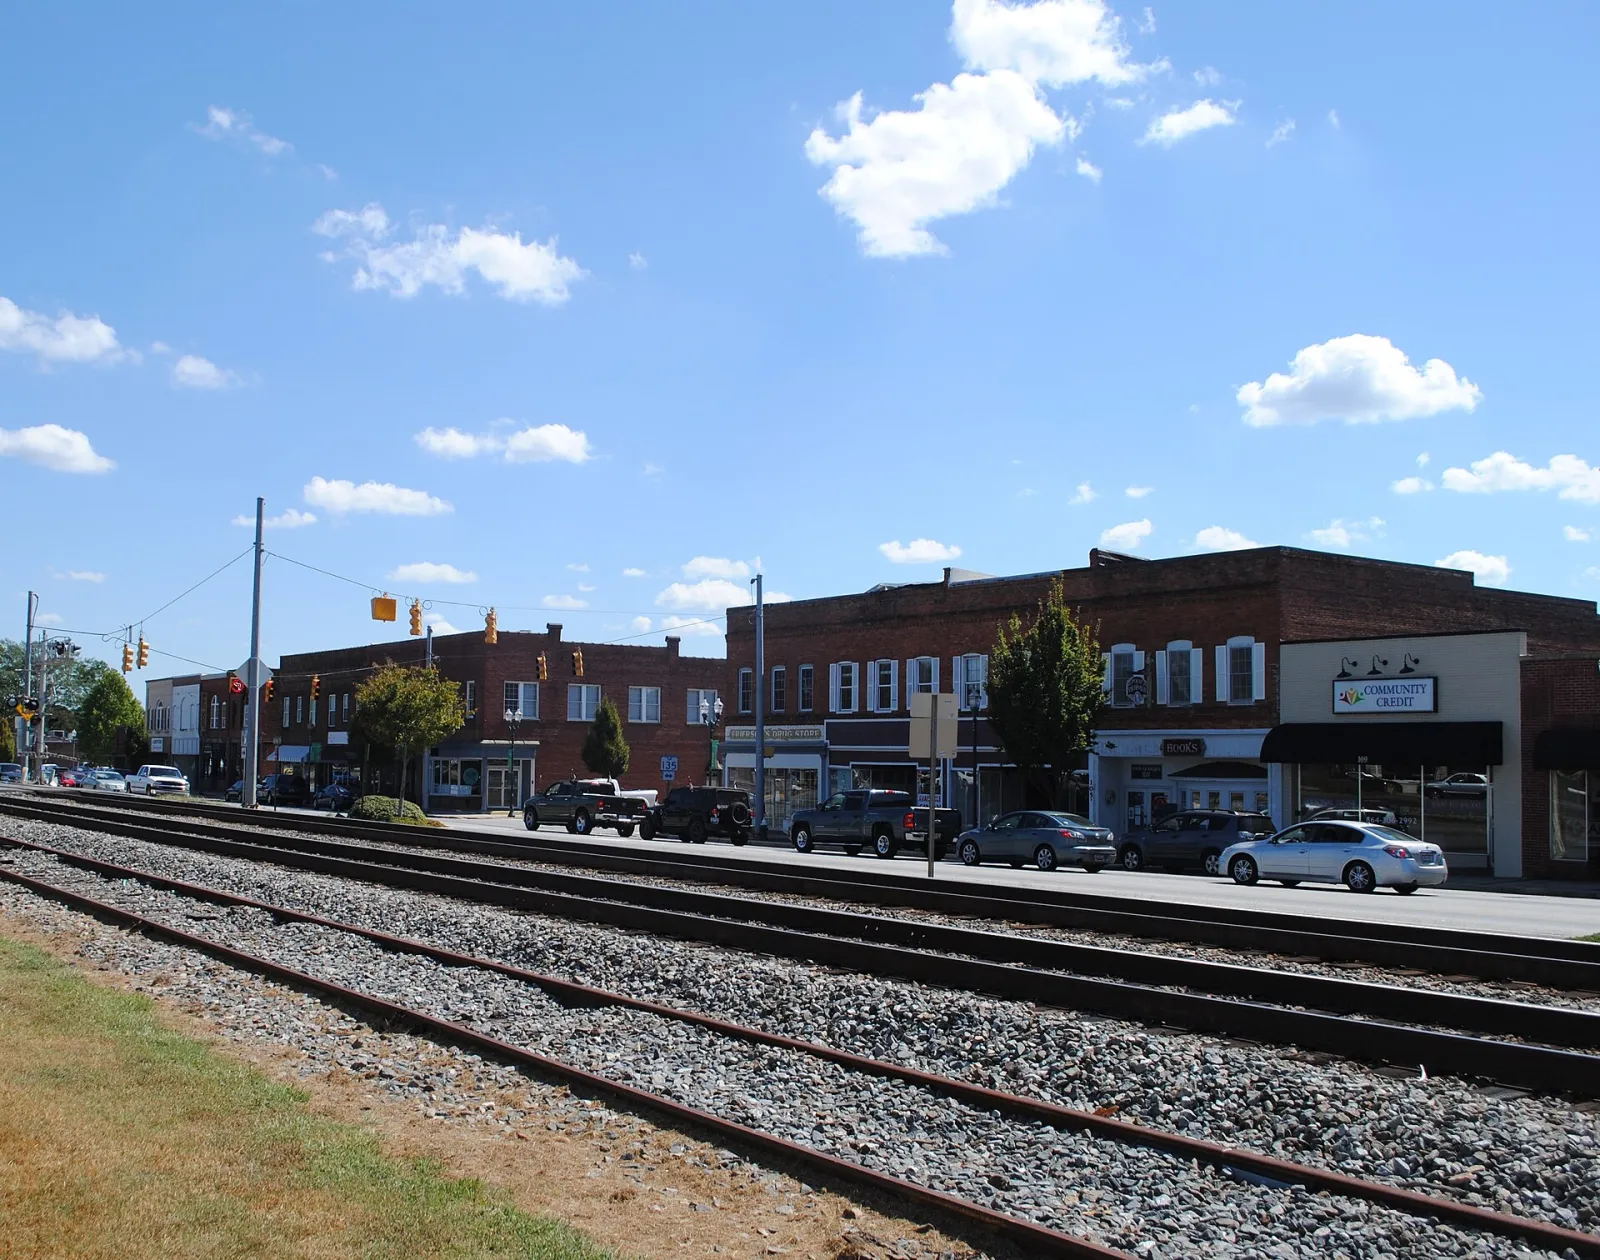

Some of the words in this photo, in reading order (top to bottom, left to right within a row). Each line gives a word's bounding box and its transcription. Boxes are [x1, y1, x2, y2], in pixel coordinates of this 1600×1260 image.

[1364, 684, 1427, 695] COMMUNITY
[1376, 696, 1414, 707] CREDIT
[772, 729, 793, 738] DRUG
[794, 729, 820, 738] STORE
[662, 761, 677, 770] 135
